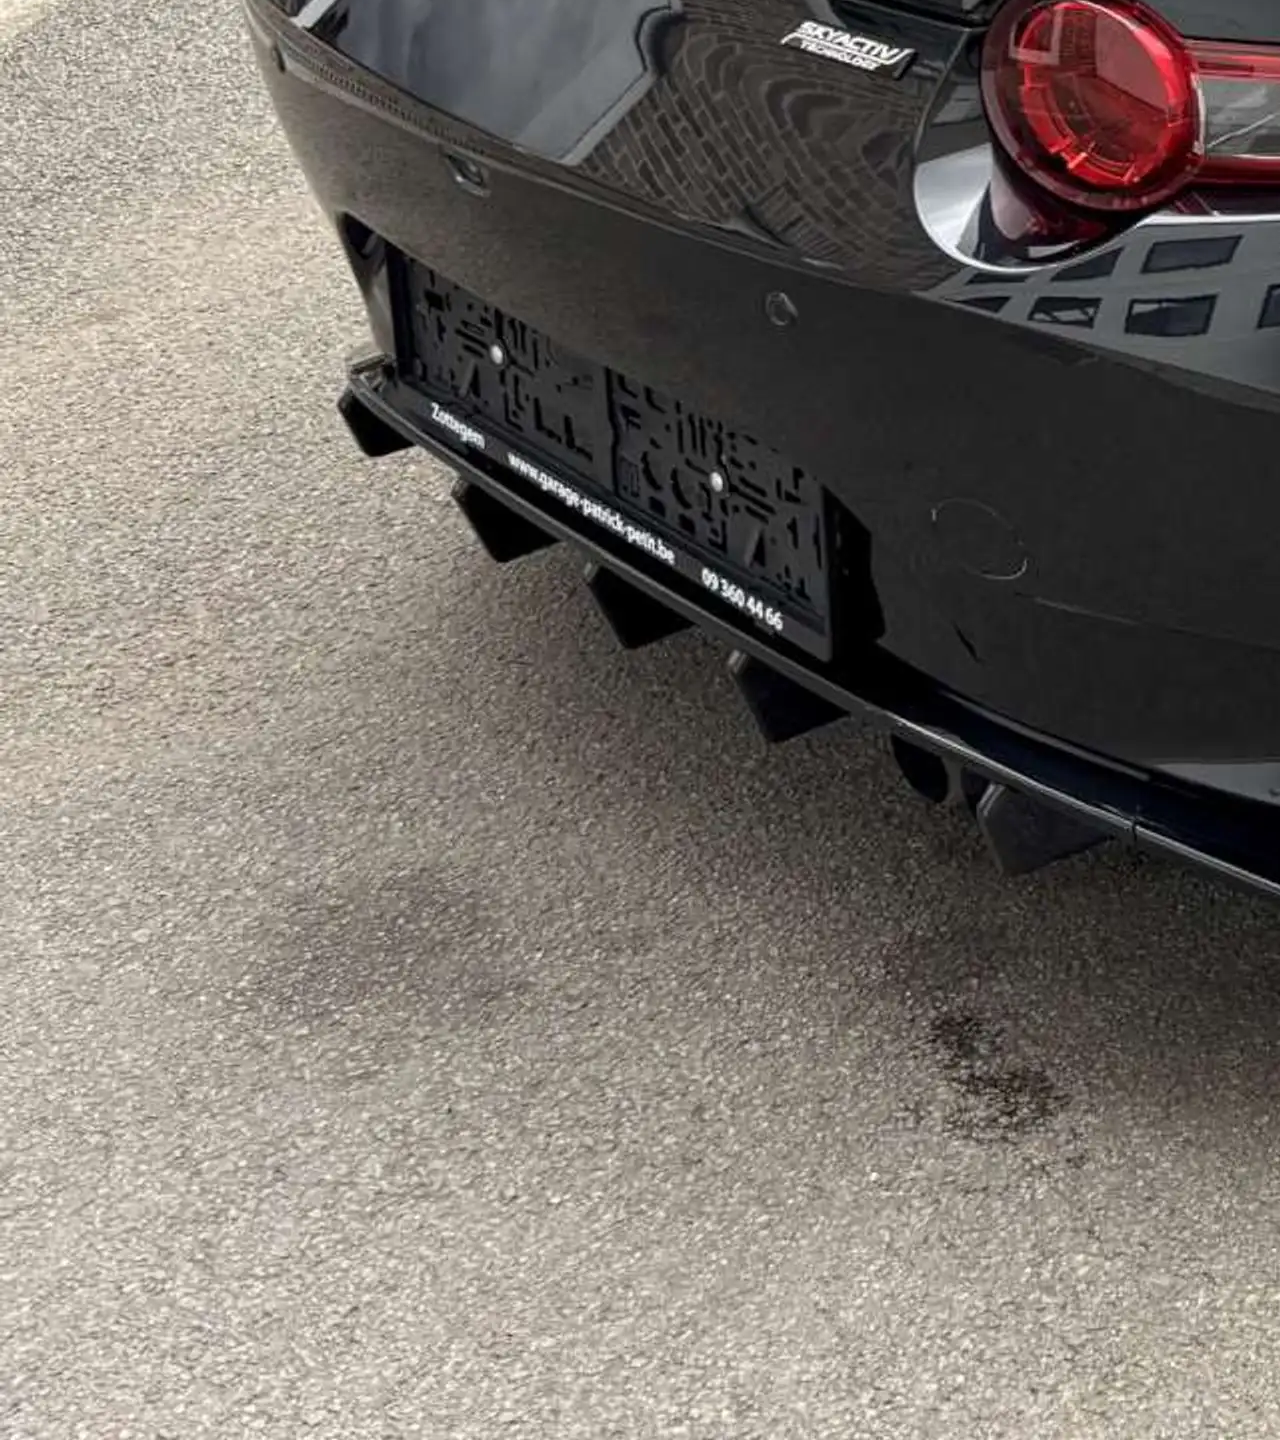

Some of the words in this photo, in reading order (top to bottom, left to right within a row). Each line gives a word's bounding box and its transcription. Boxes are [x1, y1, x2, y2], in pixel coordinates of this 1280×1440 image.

[796, 20, 901, 60] SKYACTIV
[430, 400, 485, 450] Zottegem
[701, 566, 720, 591] 09
[720, 577, 746, 608] 360
[746, 594, 764, 620] 44
[764, 606, 784, 631] 66
